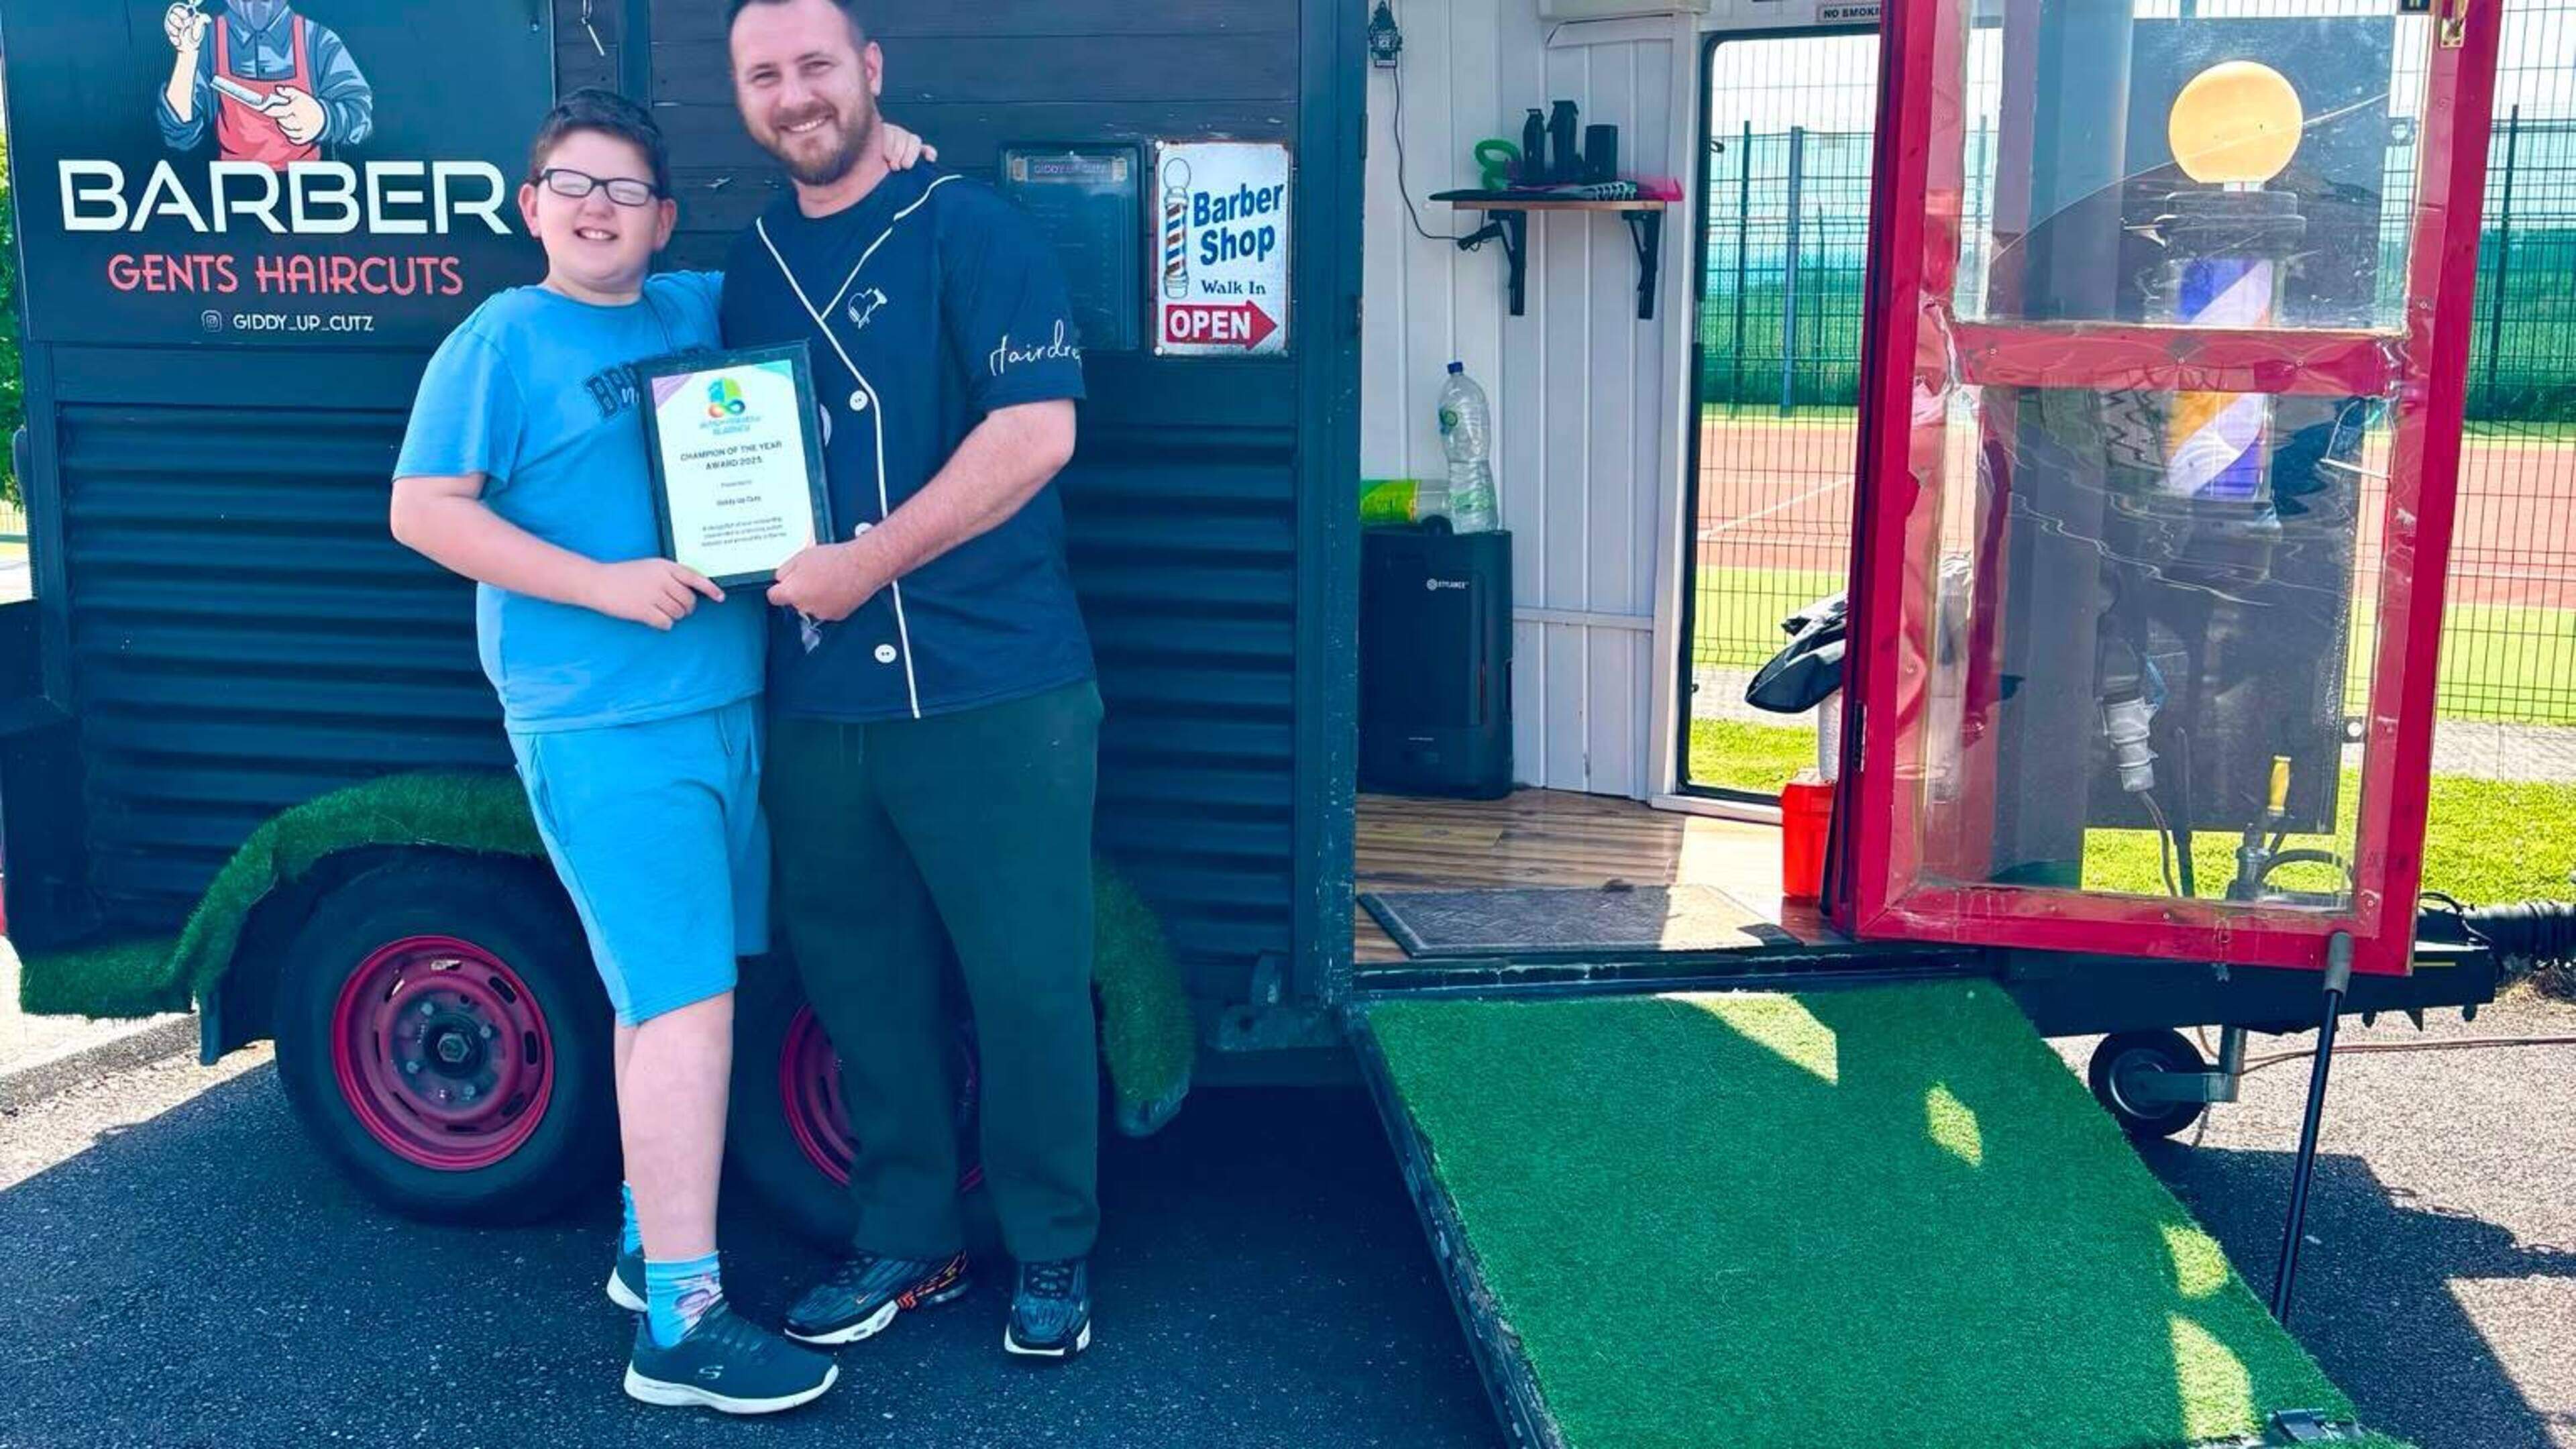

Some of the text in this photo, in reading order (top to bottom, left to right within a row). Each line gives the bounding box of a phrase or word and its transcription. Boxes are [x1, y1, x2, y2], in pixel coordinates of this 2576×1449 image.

[1824, 9, 1839, 19] NO
[59, 160, 512, 234] BARBER
[1193, 183, 1284, 227] Barber
[1199, 225, 1275, 265] Shop
[108, 254, 464, 296] GENTS HAIRCUTS
[1200, 280, 1266, 295] Walk In
[1169, 310, 1251, 340] OPEN
[680, 441, 782, 462] CHAMPION OF THE YEAR
[706, 455, 762, 470] AWARD 2025
